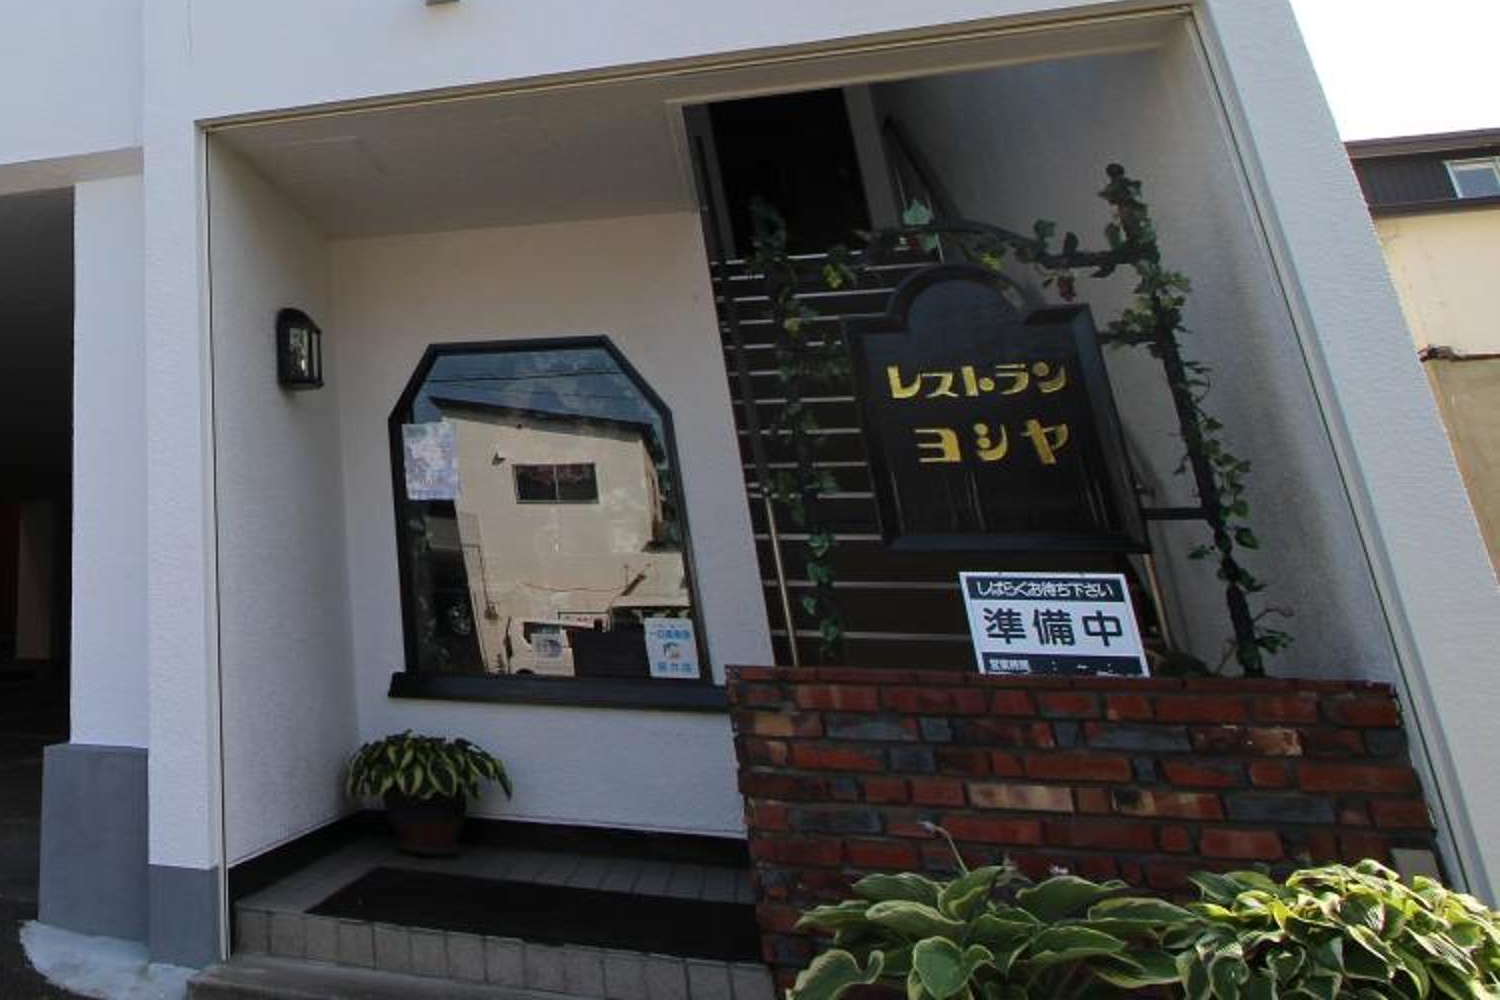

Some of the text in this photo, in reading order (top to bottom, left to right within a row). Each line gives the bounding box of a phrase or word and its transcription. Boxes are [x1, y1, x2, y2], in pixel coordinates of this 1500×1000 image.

[886, 361, 1067, 399] レストラン
[913, 418, 1069, 465] ヨシヤ
[977, 580, 1114, 598] しばらくお待ち下さい
[983, 607, 1123, 647] 準備中
